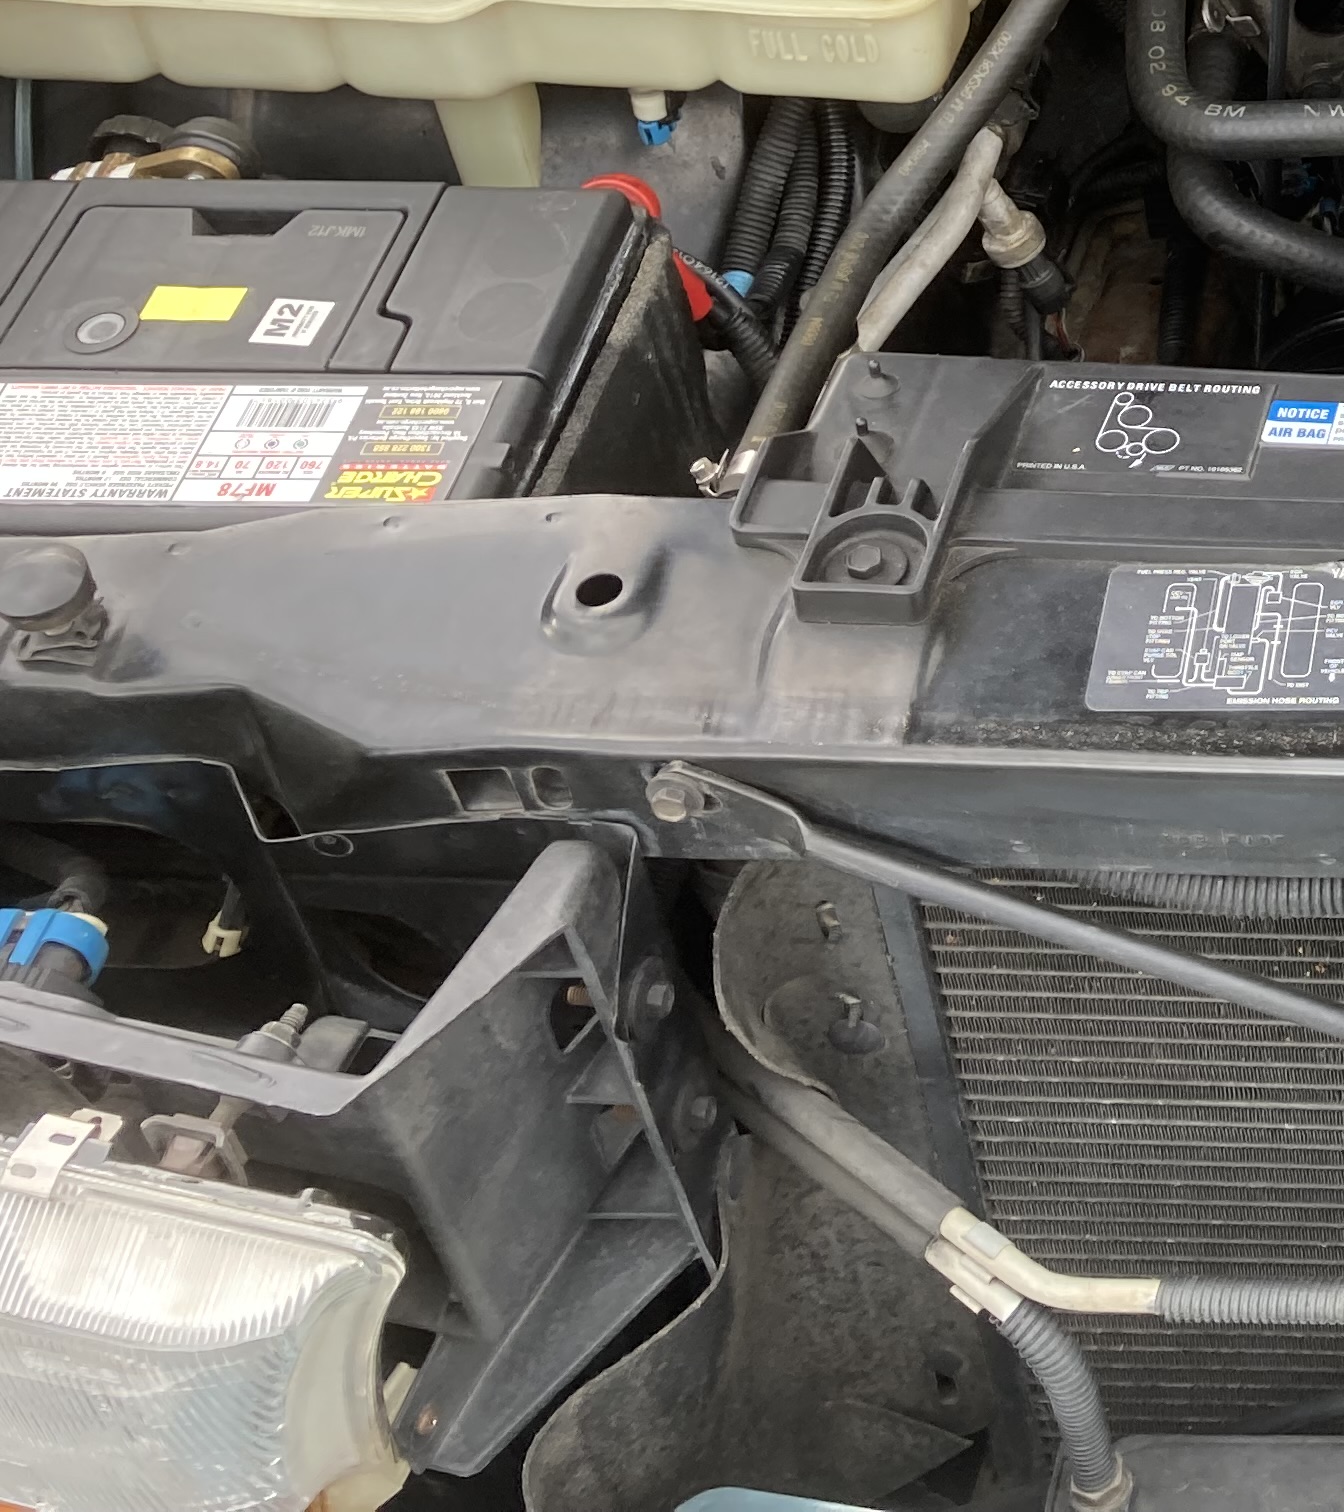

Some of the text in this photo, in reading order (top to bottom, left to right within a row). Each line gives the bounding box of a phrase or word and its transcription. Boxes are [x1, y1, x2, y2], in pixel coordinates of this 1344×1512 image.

[748, 28, 880, 64] FULL COLD
[1204, 103, 1247, 119] BM
[263, 303, 305, 338] M2
[1050, 380, 1261, 394] ACCESSORY DRIVE BELT ROUTING
[1277, 407, 1330, 420] NOTICE
[1268, 427, 1326, 439] AIR BAG
[195, 460, 220, 468] 14.8
[234, 460, 251, 469] 70
[267, 460, 288, 469] 120
[299, 460, 324, 469] 760
[336, 471, 443, 486] CHARGE
[3, 488, 169, 498] WARRANTY STATEMENT
[217, 482, 276, 497] MF78
[324, 486, 407, 499] SUPER
[1226, 697, 1270, 705] EMISSION
[1299, 697, 1339, 705] ROUTING
